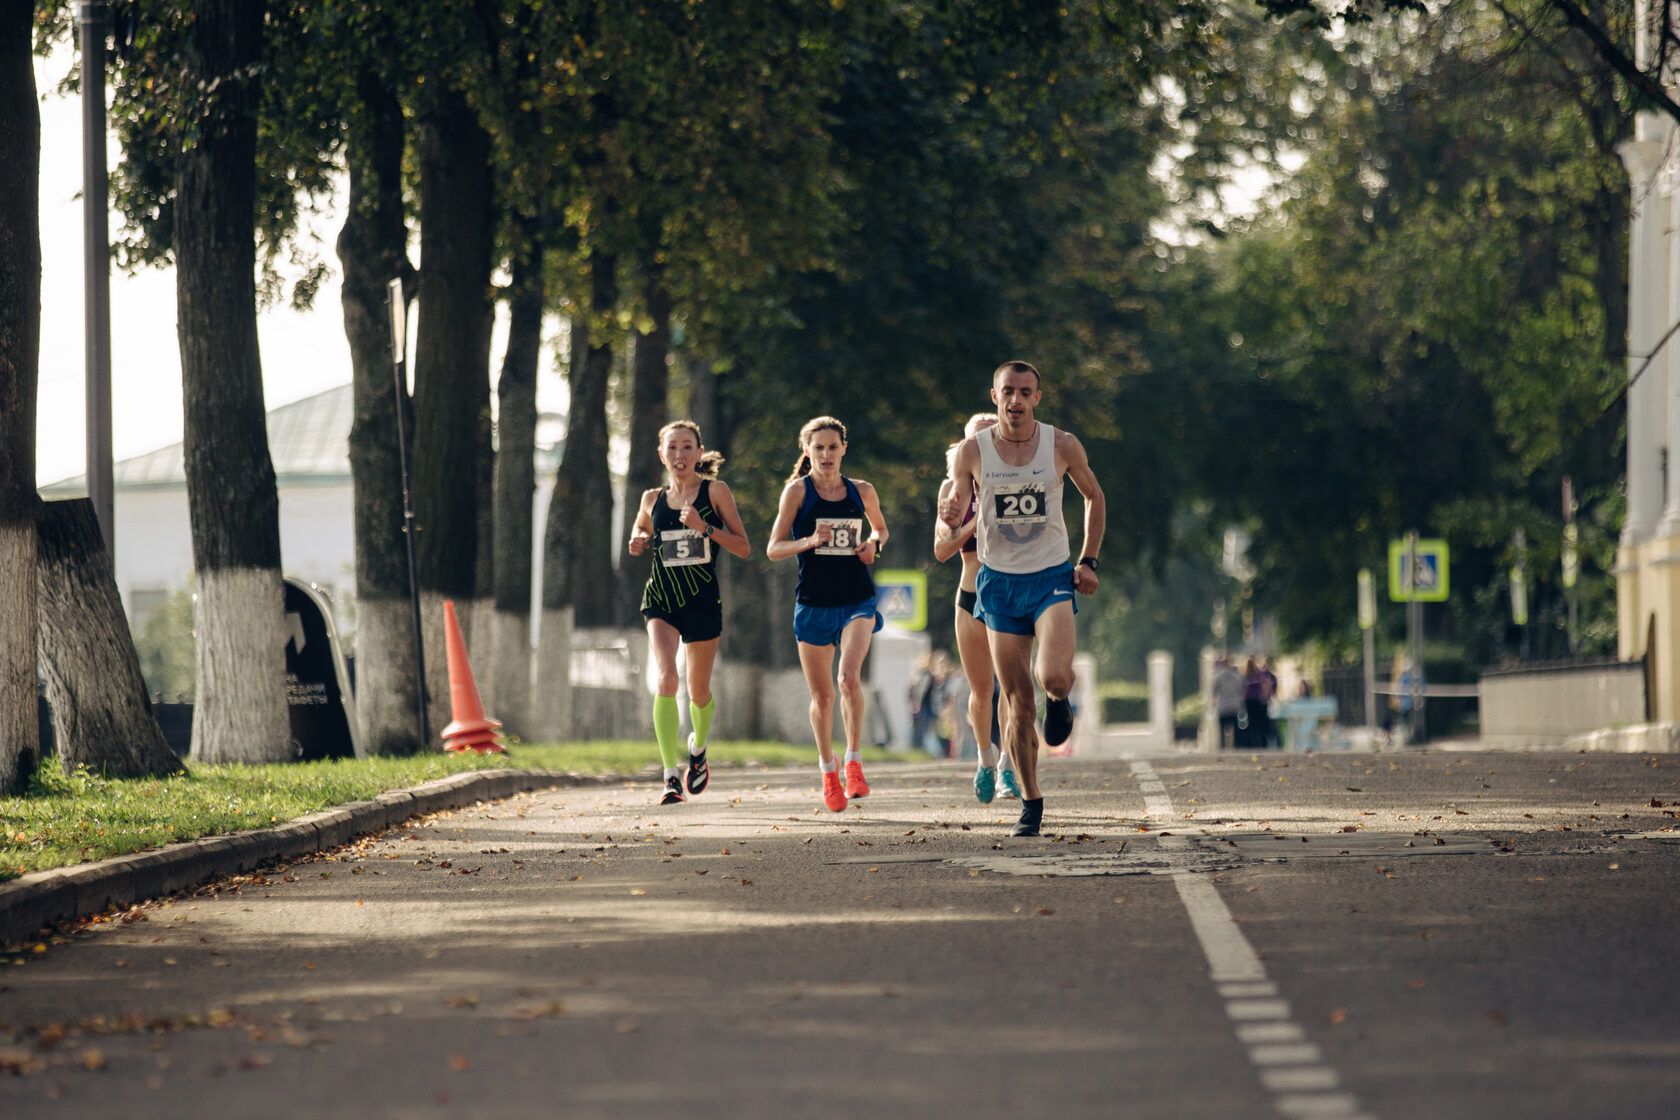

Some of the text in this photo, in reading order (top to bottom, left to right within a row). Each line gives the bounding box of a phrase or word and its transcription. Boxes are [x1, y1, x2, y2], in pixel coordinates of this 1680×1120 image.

[1003, 495, 1037, 515] 20
[828, 529, 850, 548] 18
[676, 540, 690, 559] 5
[287, 684, 326, 694] РЕДАЧИ
[287, 695, 328, 705] ТАФЕТЫ
